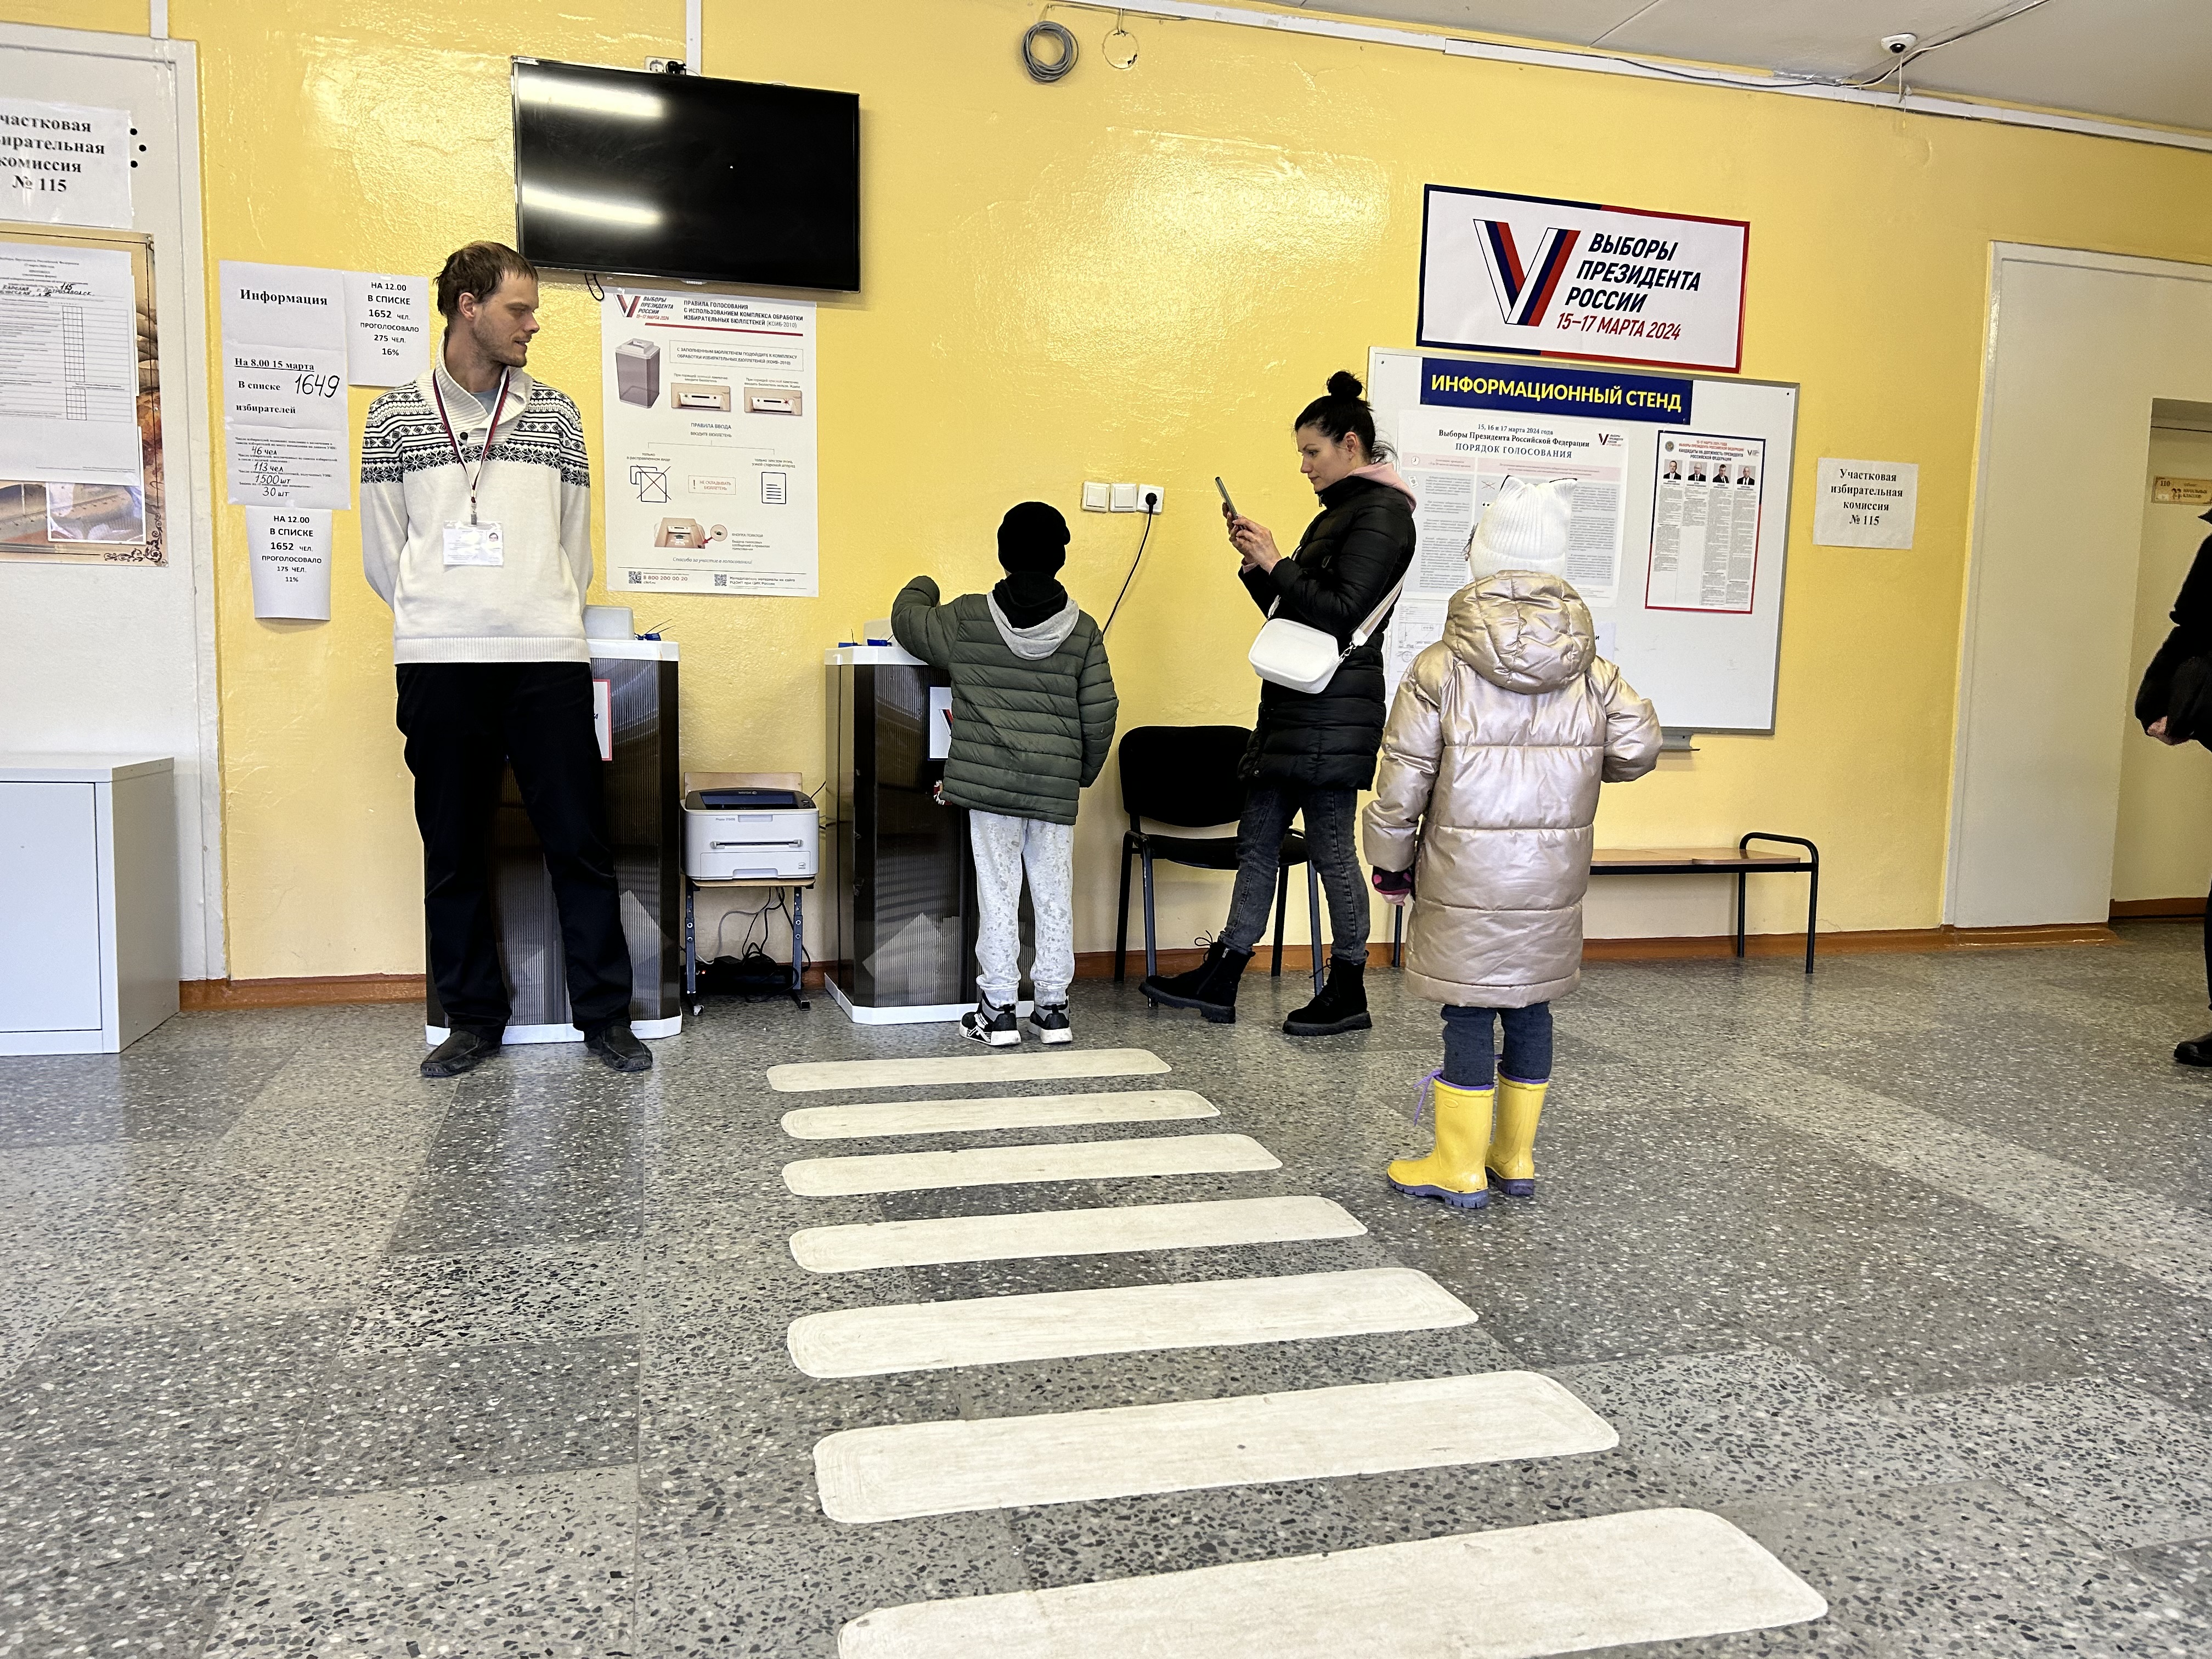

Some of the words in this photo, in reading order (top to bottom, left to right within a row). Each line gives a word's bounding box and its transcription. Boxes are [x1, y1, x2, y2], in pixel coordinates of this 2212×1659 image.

[0, 114, 92, 133] частковая
[0, 135, 105, 154] ирательная
[12, 175, 33, 189] №
[40, 178, 67, 192] 115
[1588, 232, 1679, 262] ВЫБОРЫ
[1576, 259, 1702, 292] ПРЕЗИДЕНТА
[385, 283, 407, 291] 12.00
[240, 289, 328, 306] Информация
[376, 295, 411, 306] СПИСКЕ
[1565, 287, 1648, 313] РОССИИ
[369, 309, 392, 319] 1652
[689, 308, 738, 317] ИСПОЛЬЗОВАНИЕМ
[684, 315, 730, 323] ИЗБИРАТЕЛЬНЫХ
[360, 322, 419, 332] ПРОГОЛОСОВАЛО
[1598, 317, 1646, 338] МАРТА
[1646, 322, 1681, 341] 2024
[382, 348, 399, 356] 16%
[235, 358, 248, 367] На
[250, 359, 269, 369] 8.00
[273, 360, 283, 369] 15
[285, 362, 315, 371] марта
[238, 380, 245, 388] В
[247, 382, 281, 391] списке
[294, 373, 340, 399] 1649
[1431, 374, 1622, 405] ИНФОРМАЦИОННЫЙ
[1626, 390, 1682, 413] СТЕНД
[236, 404, 296, 414] избирателей
[1438, 429, 1468, 439] Выборы
[1469, 431, 1510, 442] Президента
[1511, 435, 1551, 445] Российской
[1552, 438, 1590, 448] Федерации
[1455, 443, 1500, 454] ПОРЯДОК
[1502, 445, 1572, 459] ГОЛОСОВАНИЯ
[254, 461, 268, 472] 113
[255, 475, 279, 485] 1500
[1839, 469, 1897, 482] Участковая
[262, 486, 276, 496] 30
[1831, 484, 1903, 497] избирательная
[1843, 501, 1889, 511] комиссия
[1849, 515, 1860, 524] №
[1863, 515, 1880, 526] 115
[278, 528, 314, 537] СПИСКЕ
[270, 541, 294, 551] 1652
[262, 555, 322, 563] ПРОГОЛОСОВАЛО
